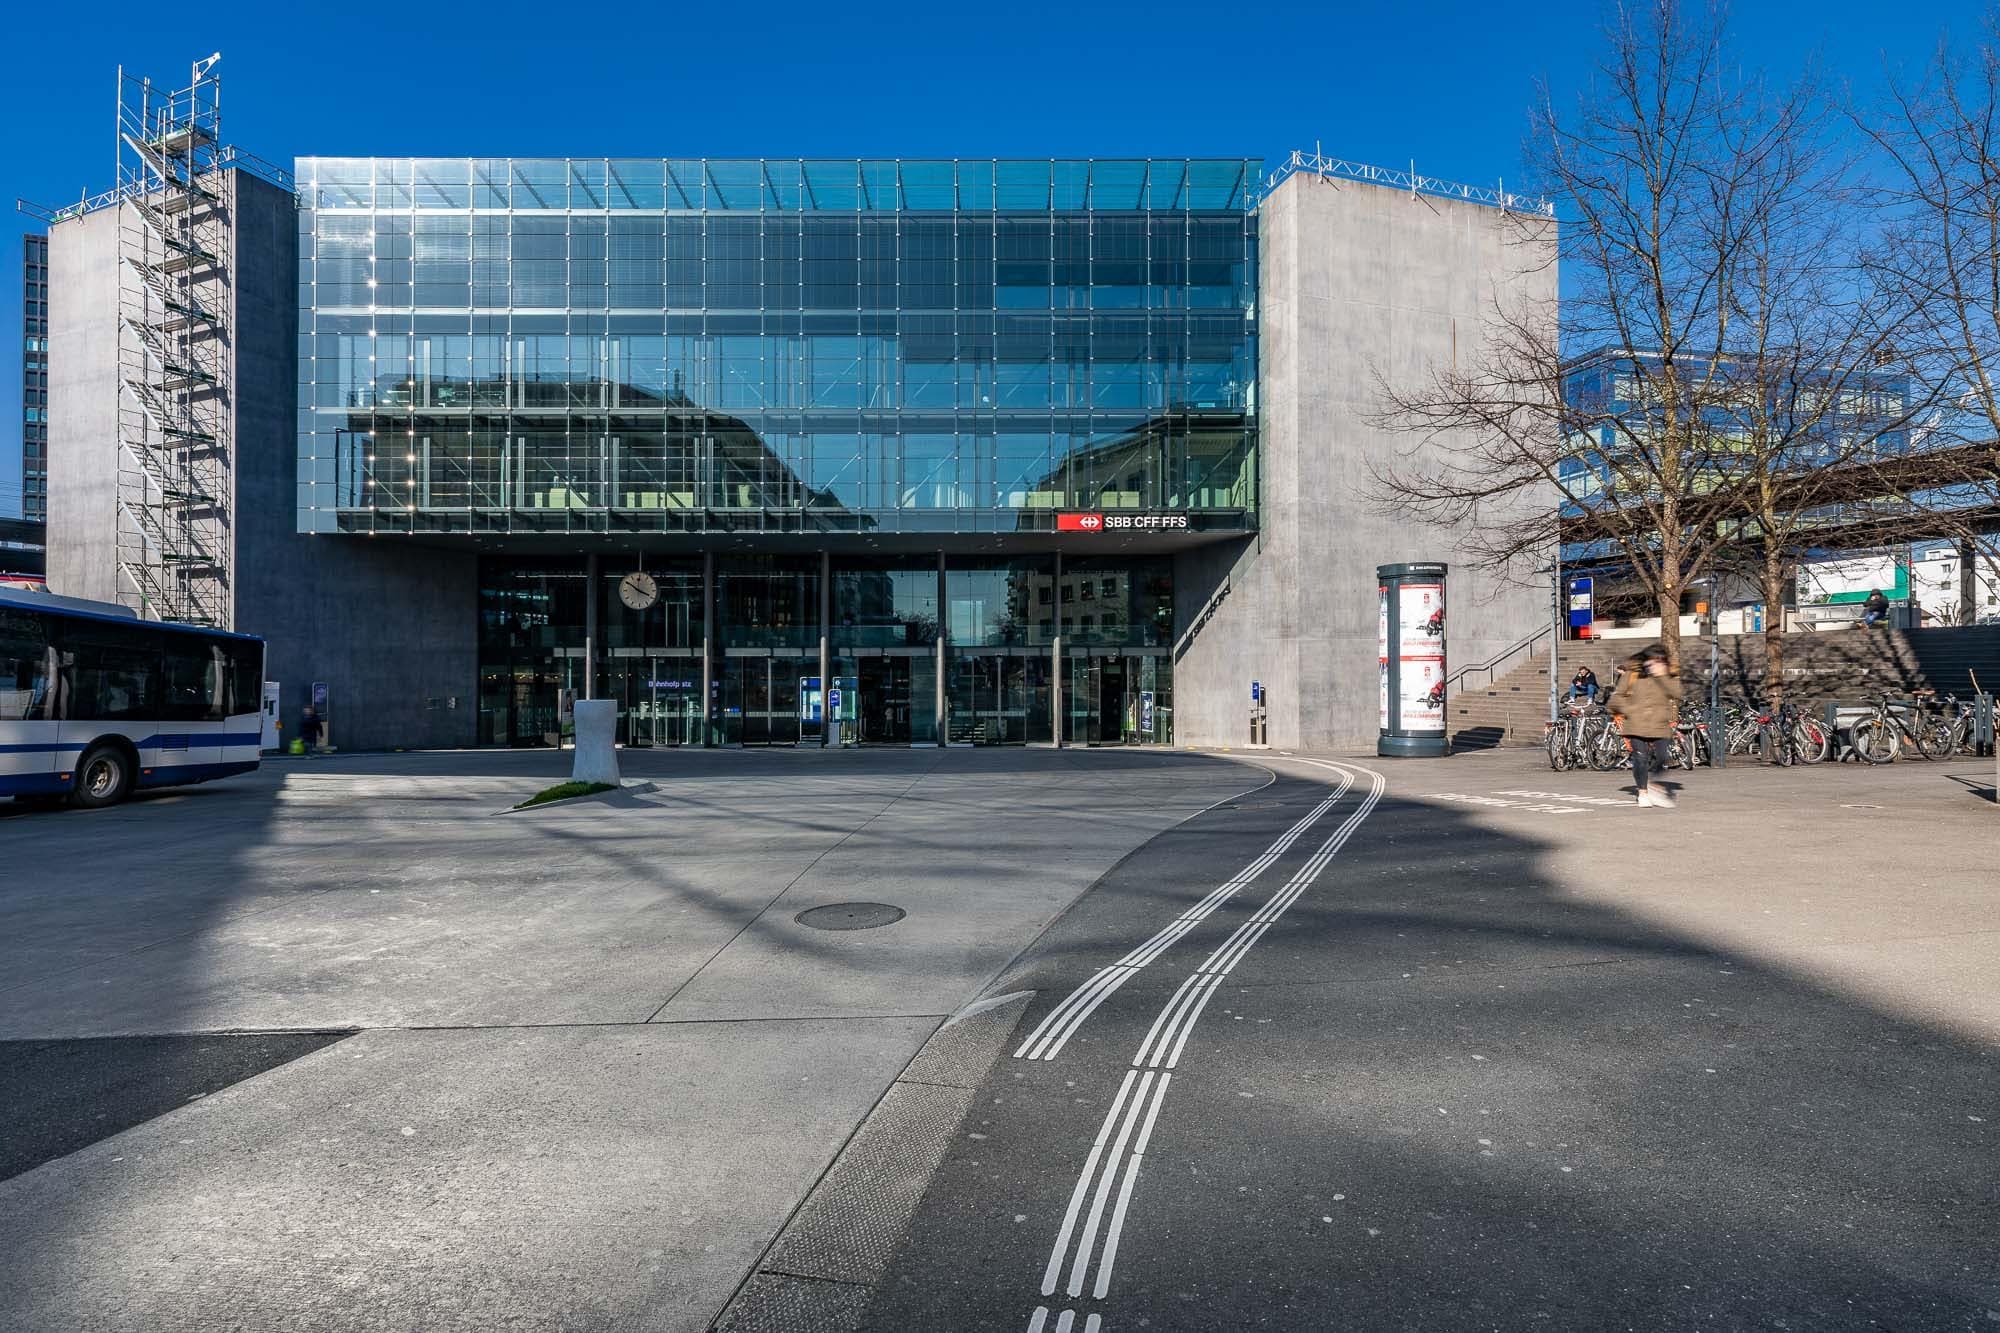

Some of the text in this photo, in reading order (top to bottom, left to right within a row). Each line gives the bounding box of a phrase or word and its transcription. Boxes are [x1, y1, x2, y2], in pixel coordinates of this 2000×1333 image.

[1105, 516, 1187, 527] SBB CFF FFS
